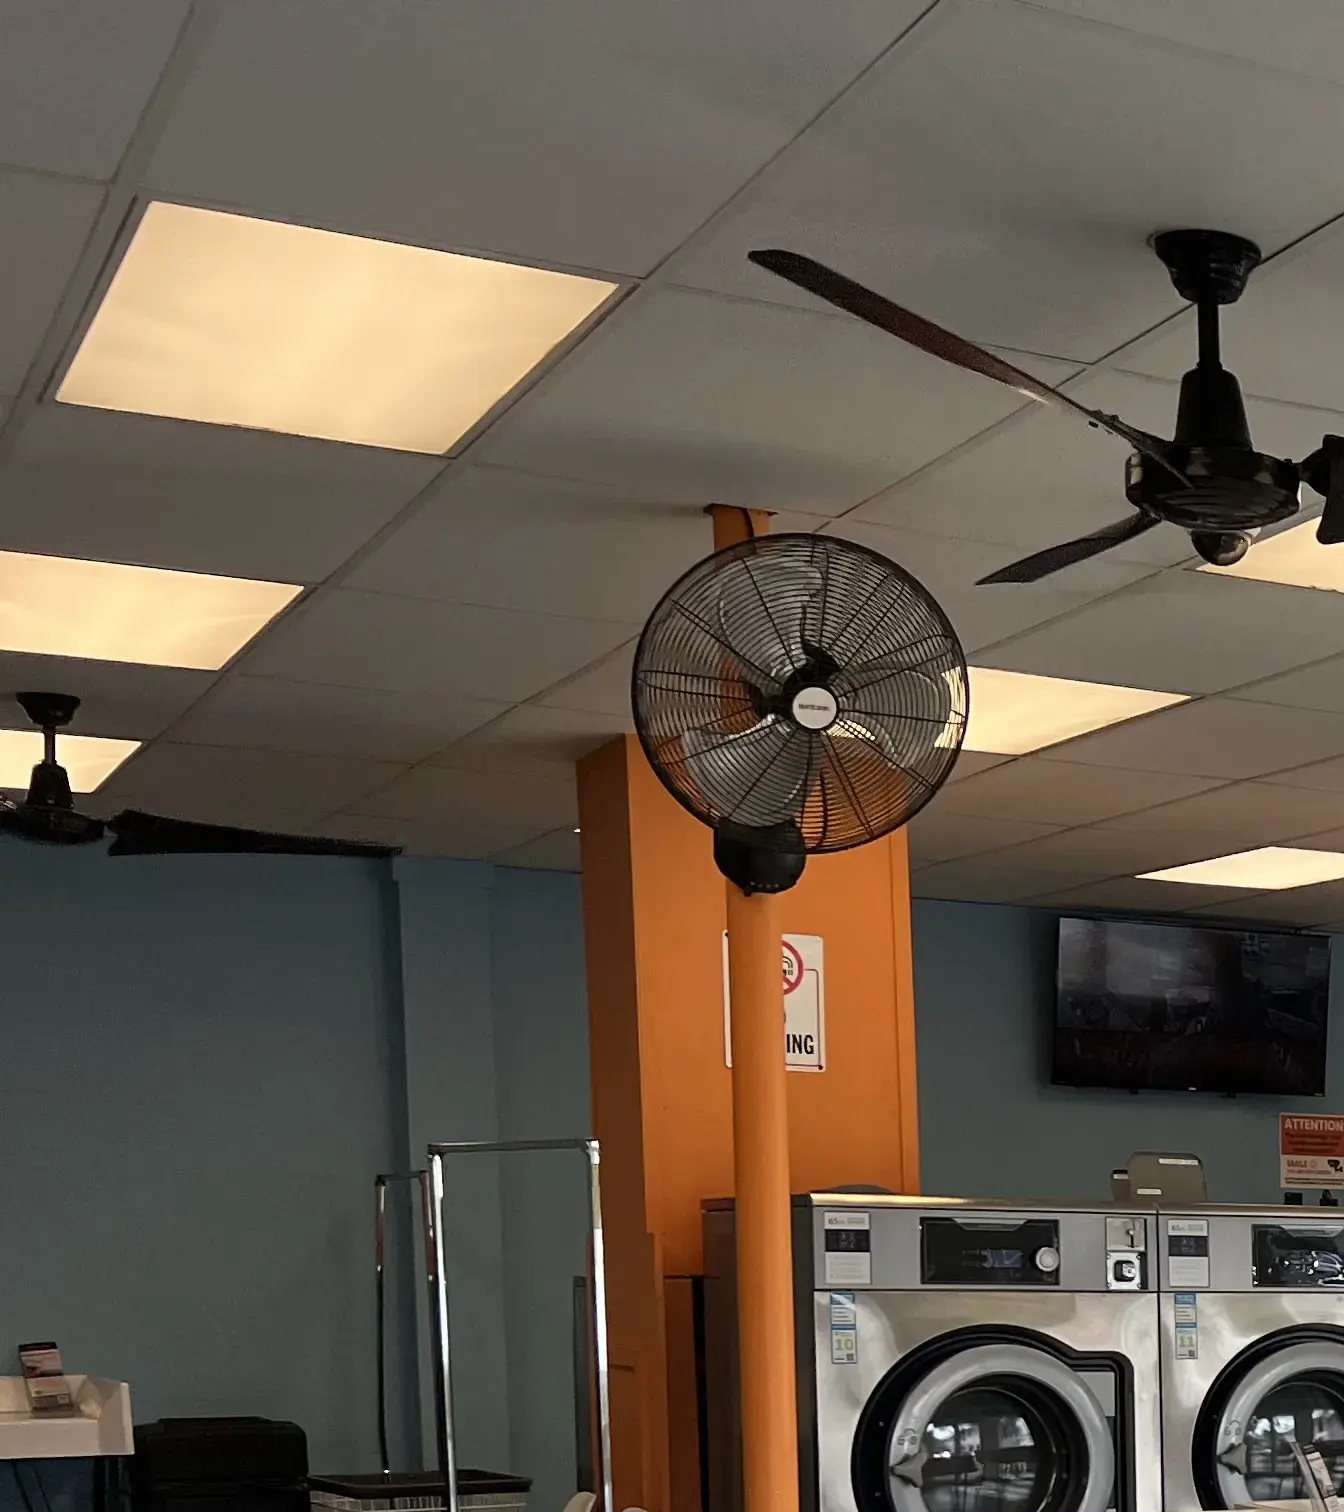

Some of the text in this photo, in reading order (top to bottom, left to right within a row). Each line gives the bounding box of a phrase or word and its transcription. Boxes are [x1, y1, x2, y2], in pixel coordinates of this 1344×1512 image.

[1284, 1118, 1344, 1131] ATTENTION
[835, 1338, 854, 1351] 10
[1179, 1336, 1194, 1348] 11
